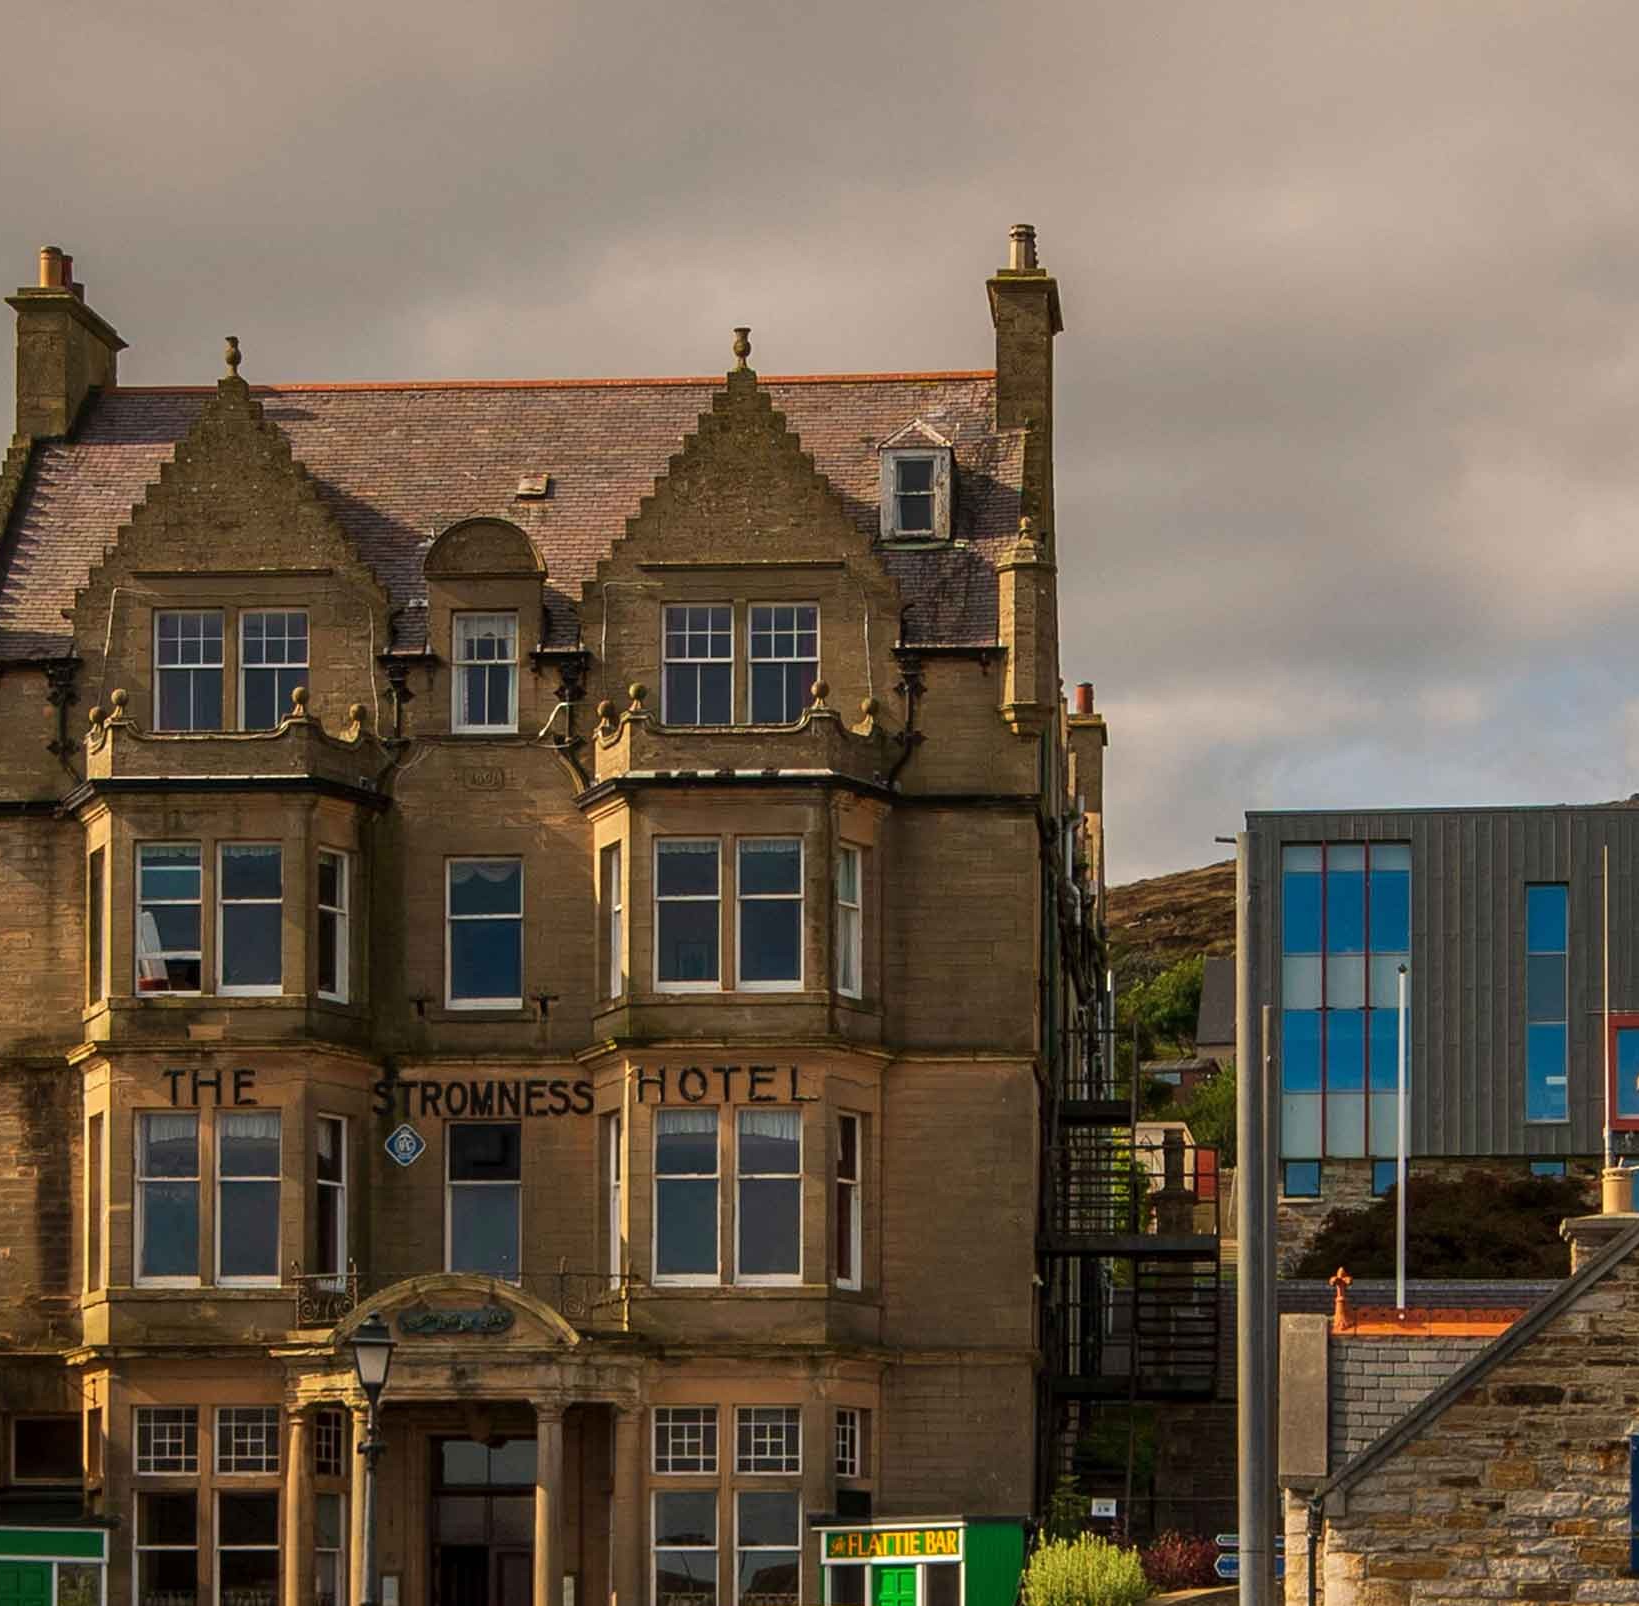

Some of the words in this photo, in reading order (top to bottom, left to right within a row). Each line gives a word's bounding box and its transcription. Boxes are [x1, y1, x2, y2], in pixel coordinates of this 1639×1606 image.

[163, 1068, 258, 1105] THE
[372, 1080, 594, 1116] STROMNESS
[636, 1065, 821, 1102] HOTEL
[847, 1531, 920, 1556] FLATTIE
[925, 1530, 958, 1554] BAR
